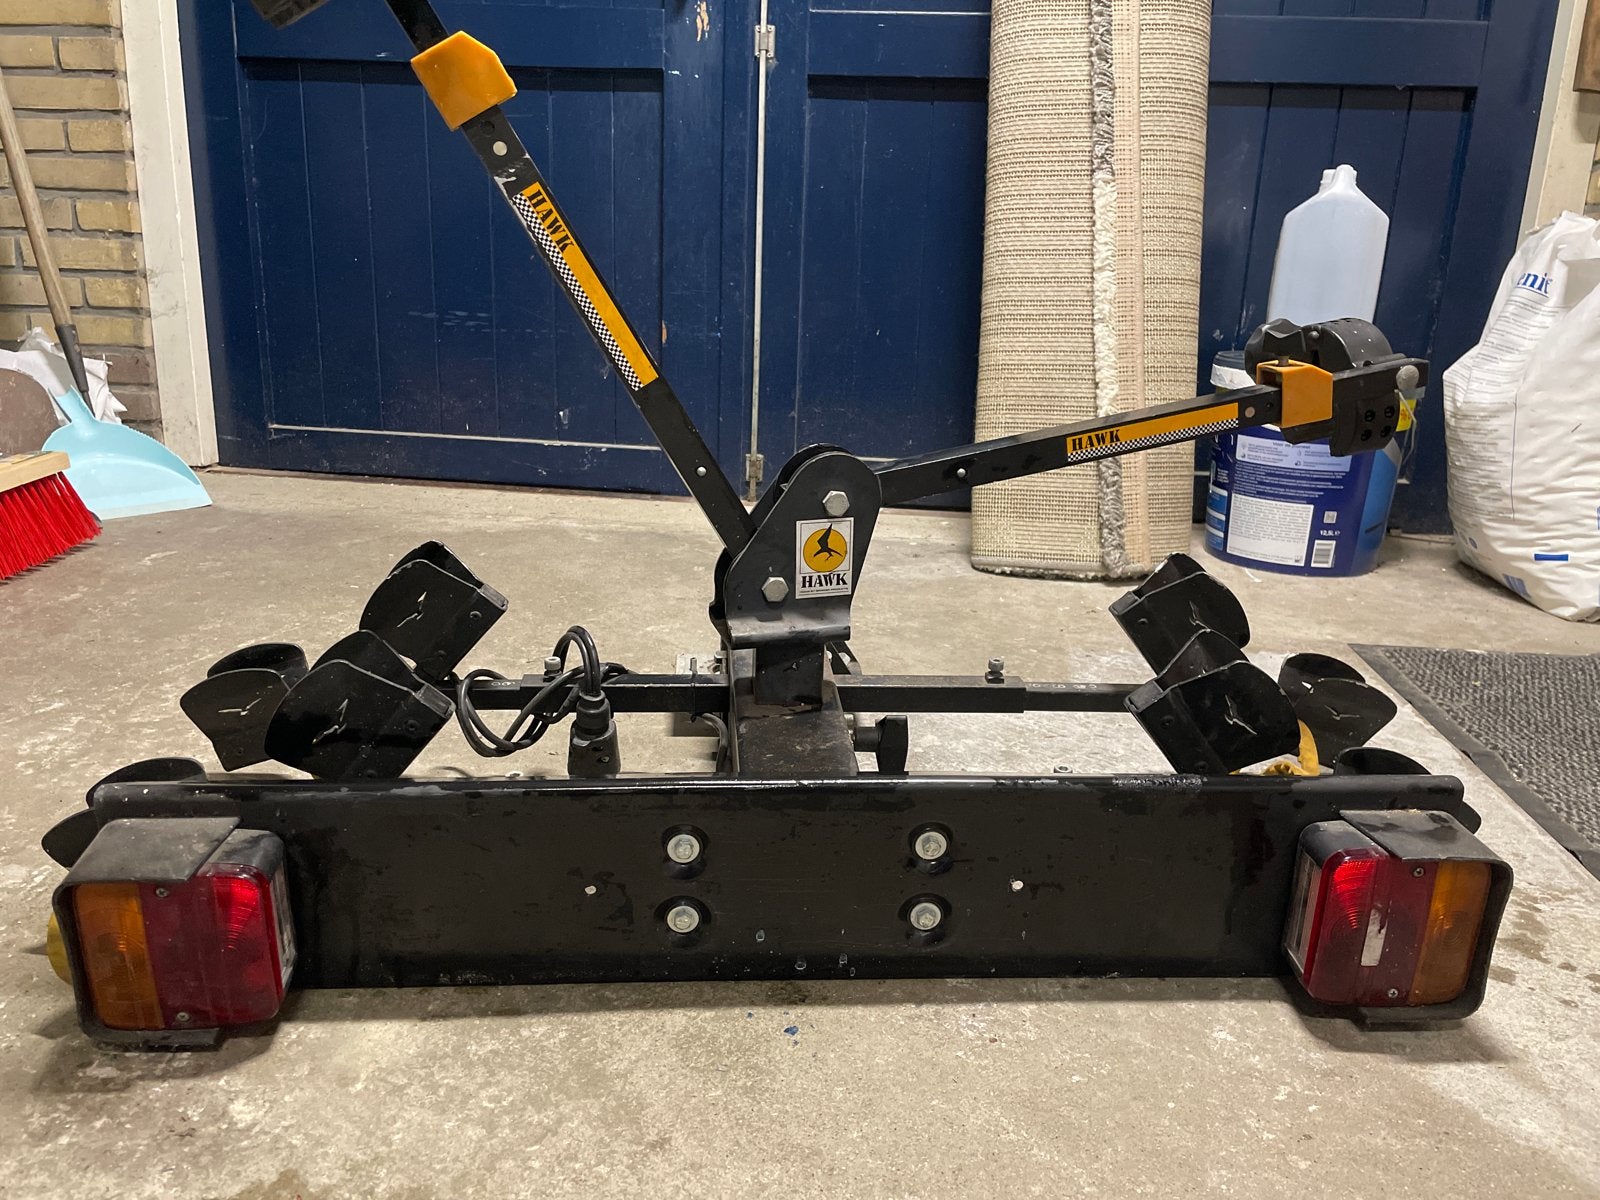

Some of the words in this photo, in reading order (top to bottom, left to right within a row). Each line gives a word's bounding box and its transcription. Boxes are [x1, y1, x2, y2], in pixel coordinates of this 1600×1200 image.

[527, 189, 575, 253] HAWK
[1071, 429, 1121, 451] HAWK
[801, 572, 848, 588] HAWK
